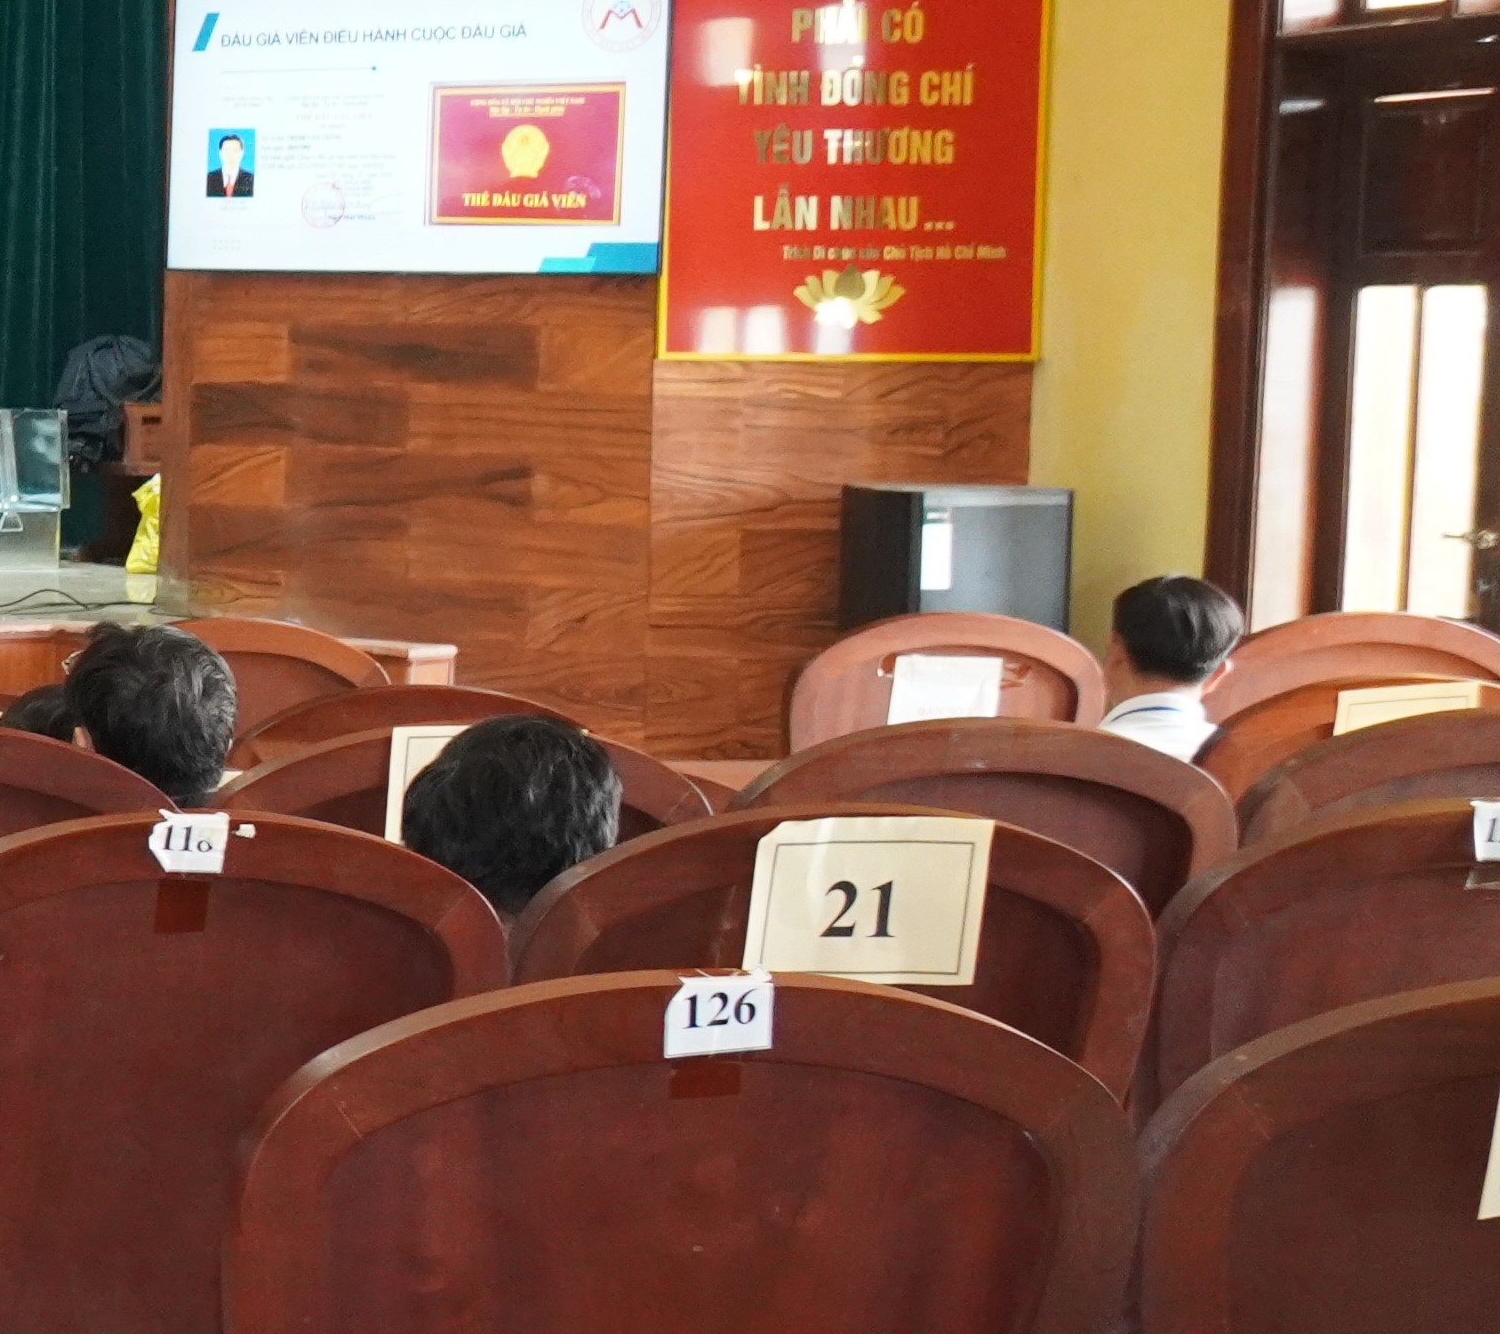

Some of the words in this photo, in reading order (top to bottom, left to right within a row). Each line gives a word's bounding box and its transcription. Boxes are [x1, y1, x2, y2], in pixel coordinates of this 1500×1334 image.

[881, 1, 925, 43] CÓ
[735, 64, 809, 106] TÌNH
[820, 55, 910, 106] ĐỒNG
[919, 63, 975, 106] CHÍ
[754, 124, 812, 165] YÊU
[824, 127, 955, 165] THƯƠNG
[753, 183, 818, 231] LẪN
[820, 879, 897, 939] 21
[682, 990, 757, 1030] 126
